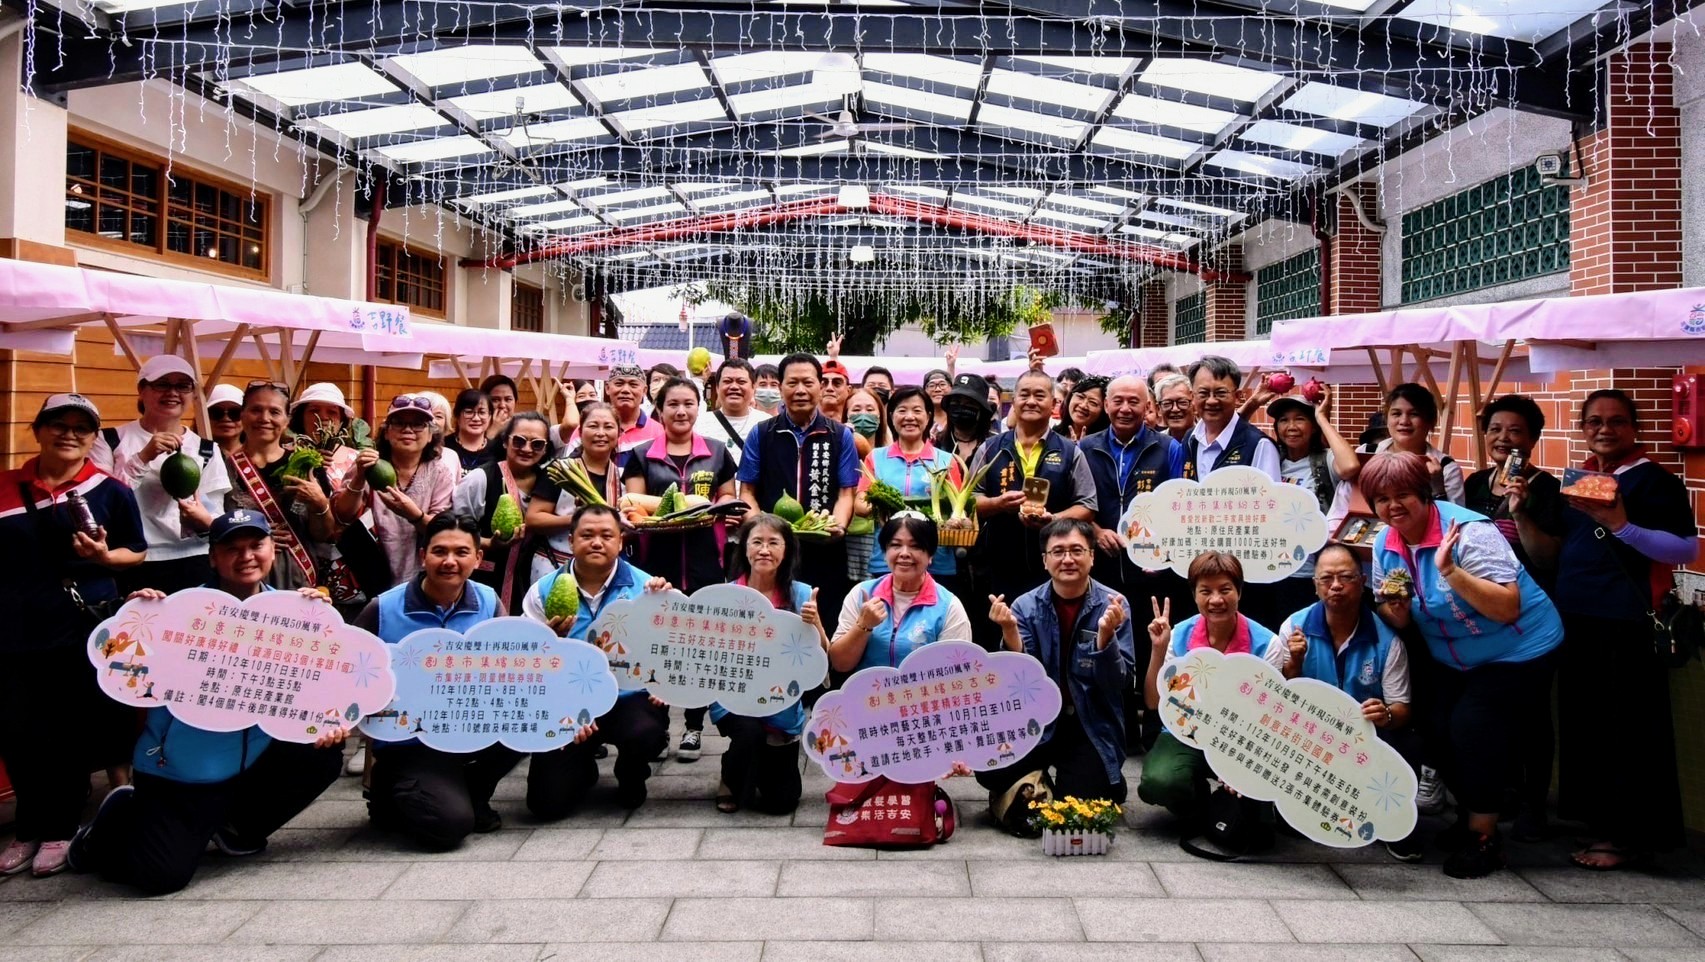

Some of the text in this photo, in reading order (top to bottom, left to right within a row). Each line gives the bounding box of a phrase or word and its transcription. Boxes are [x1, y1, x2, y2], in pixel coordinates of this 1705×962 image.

[1185, 487, 1257, 497] 吉安慶雙十再現50風華
[1171, 499, 1277, 511] 創意市集繽紛吉安
[218, 605, 322, 631] 吉安慶雙十再現50風華
[671, 602, 756, 619] 吉安慶雙十再現50風華
[191, 618, 341, 655] 創意市集繽紛吉安
[653, 614, 775, 638] 創意市集繽紛吉安
[445, 641, 539, 651] 吉安慶雙十再現50風華
[668, 631, 756, 652] 三五好友來去吉野村
[187, 650, 321, 682] 日期：112年10月7日至10日
[424, 656, 561, 669] 創意市集繽紛吉安
[651, 644, 771, 668] 日期：112年10月7日至9日
[206, 667, 302, 692] 時間：下午3點至5點
[664, 659, 754, 679] 時間：下午3點至5點
[883, 662, 971, 687] 吉安慶雙十再現50風華
[200, 680, 295, 704] 地點：原住民產業館
[430, 685, 546, 695] 112年10月7日、8日、10日
[668, 674, 746, 693] 地點：吉野藝文館
[868, 673, 997, 707] 創意市集繽紛吉安
[446, 697, 529, 707] 下午2點、4點、6點
[1263, 677, 1355, 736] 吉安慶雙十再現50風華
[423, 710, 549, 720] 112年10月9日 下午2點、6點
[858, 699, 1022, 741] 限時快閃藝文展演 10月7日至10日
[1239, 681, 1369, 765] 創意市集繽紛吉安
[431, 723, 539, 733] 地點：10號館及桐花廣場
[896, 720, 990, 748] 每天整點不定時演出
[1220, 707, 1360, 800] 時間：112年10月9日下午4點至6點
[860, 809, 912, 821] 樂活吉安
